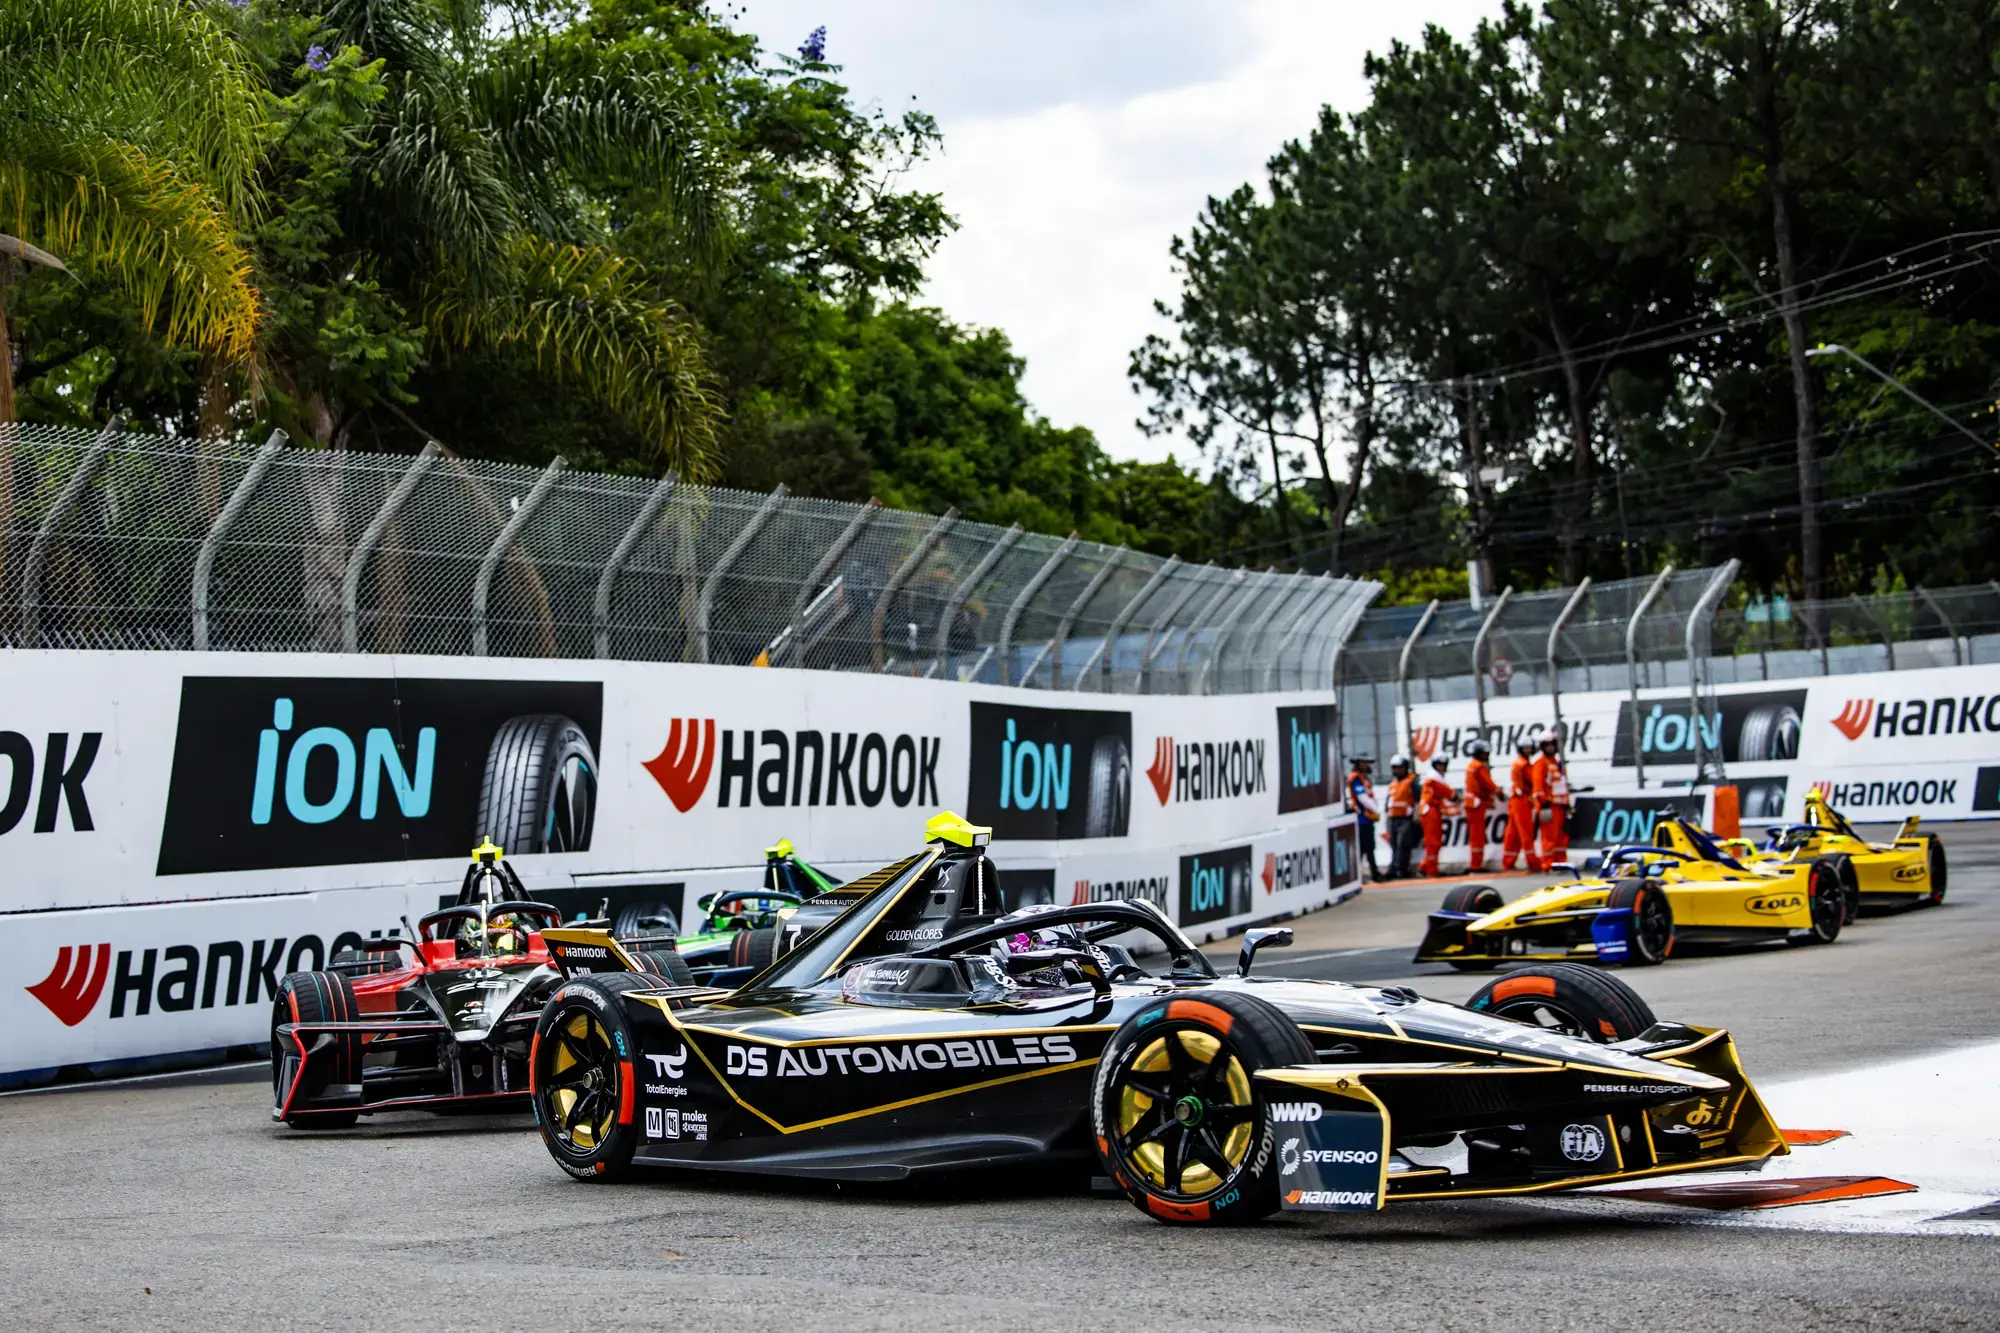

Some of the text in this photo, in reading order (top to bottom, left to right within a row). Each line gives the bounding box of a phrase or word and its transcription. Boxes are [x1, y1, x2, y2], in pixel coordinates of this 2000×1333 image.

[1751, 896, 1801, 910] LOLA
[886, 928, 943, 941] GOLDEN GLOBES
[728, 1045, 768, 1076] DS
[776, 1035, 1077, 1077] AUTOMOBILES
[645, 1084, 687, 1097] TotalEnergies
[1584, 1084, 1693, 1094] PENSKE AUTOSPORT
[682, 1110, 707, 1122] molex
[1271, 1102, 1323, 1122] WWD
[1302, 1150, 1378, 1164] SYENSQO
